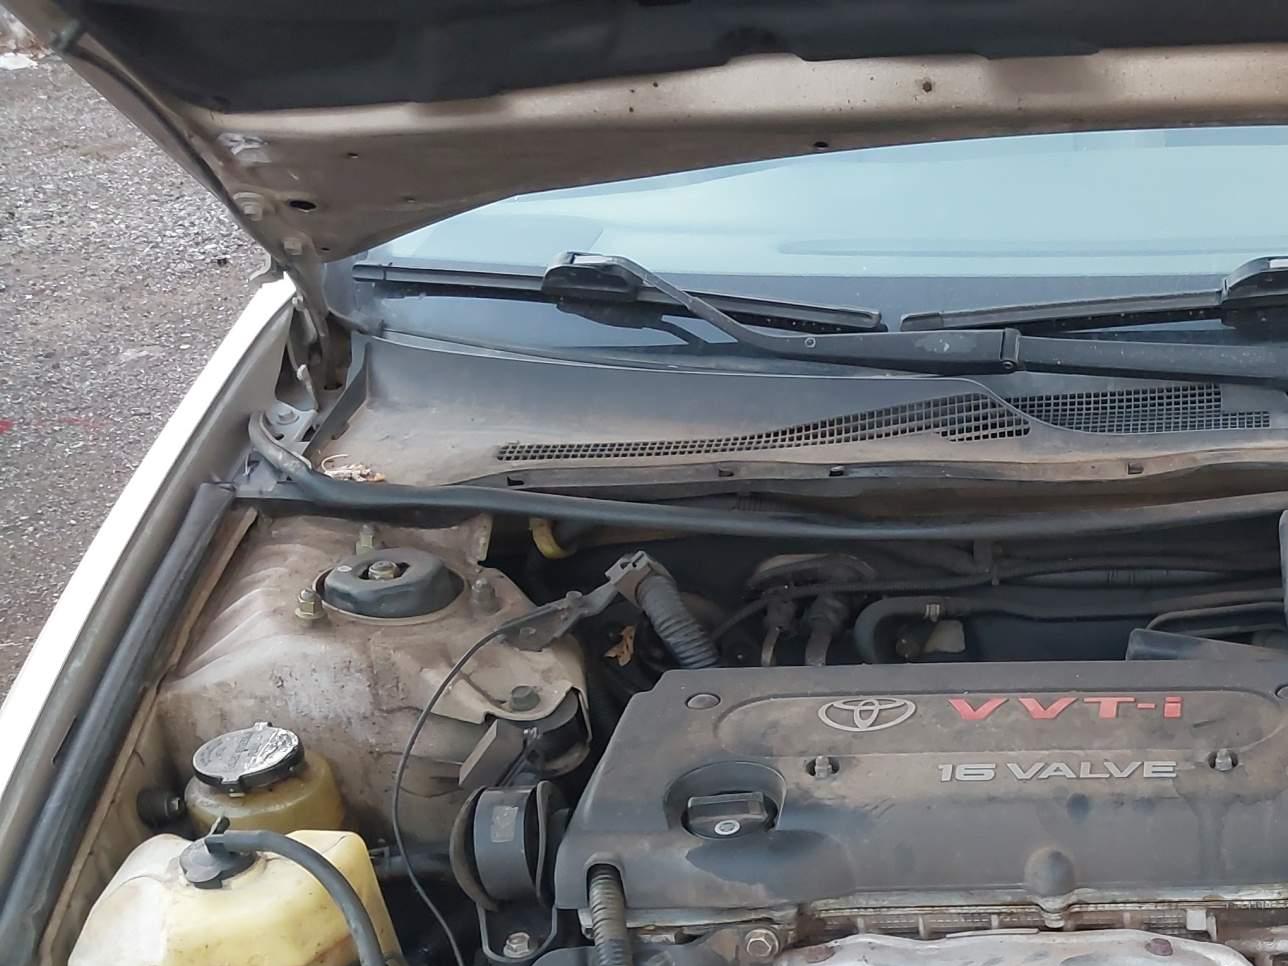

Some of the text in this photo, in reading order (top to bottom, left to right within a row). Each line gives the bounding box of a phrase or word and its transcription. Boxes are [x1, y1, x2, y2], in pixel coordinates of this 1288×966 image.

[948, 696, 1183, 721] VVT-i
[938, 758, 1179, 784] 16 VALVE
